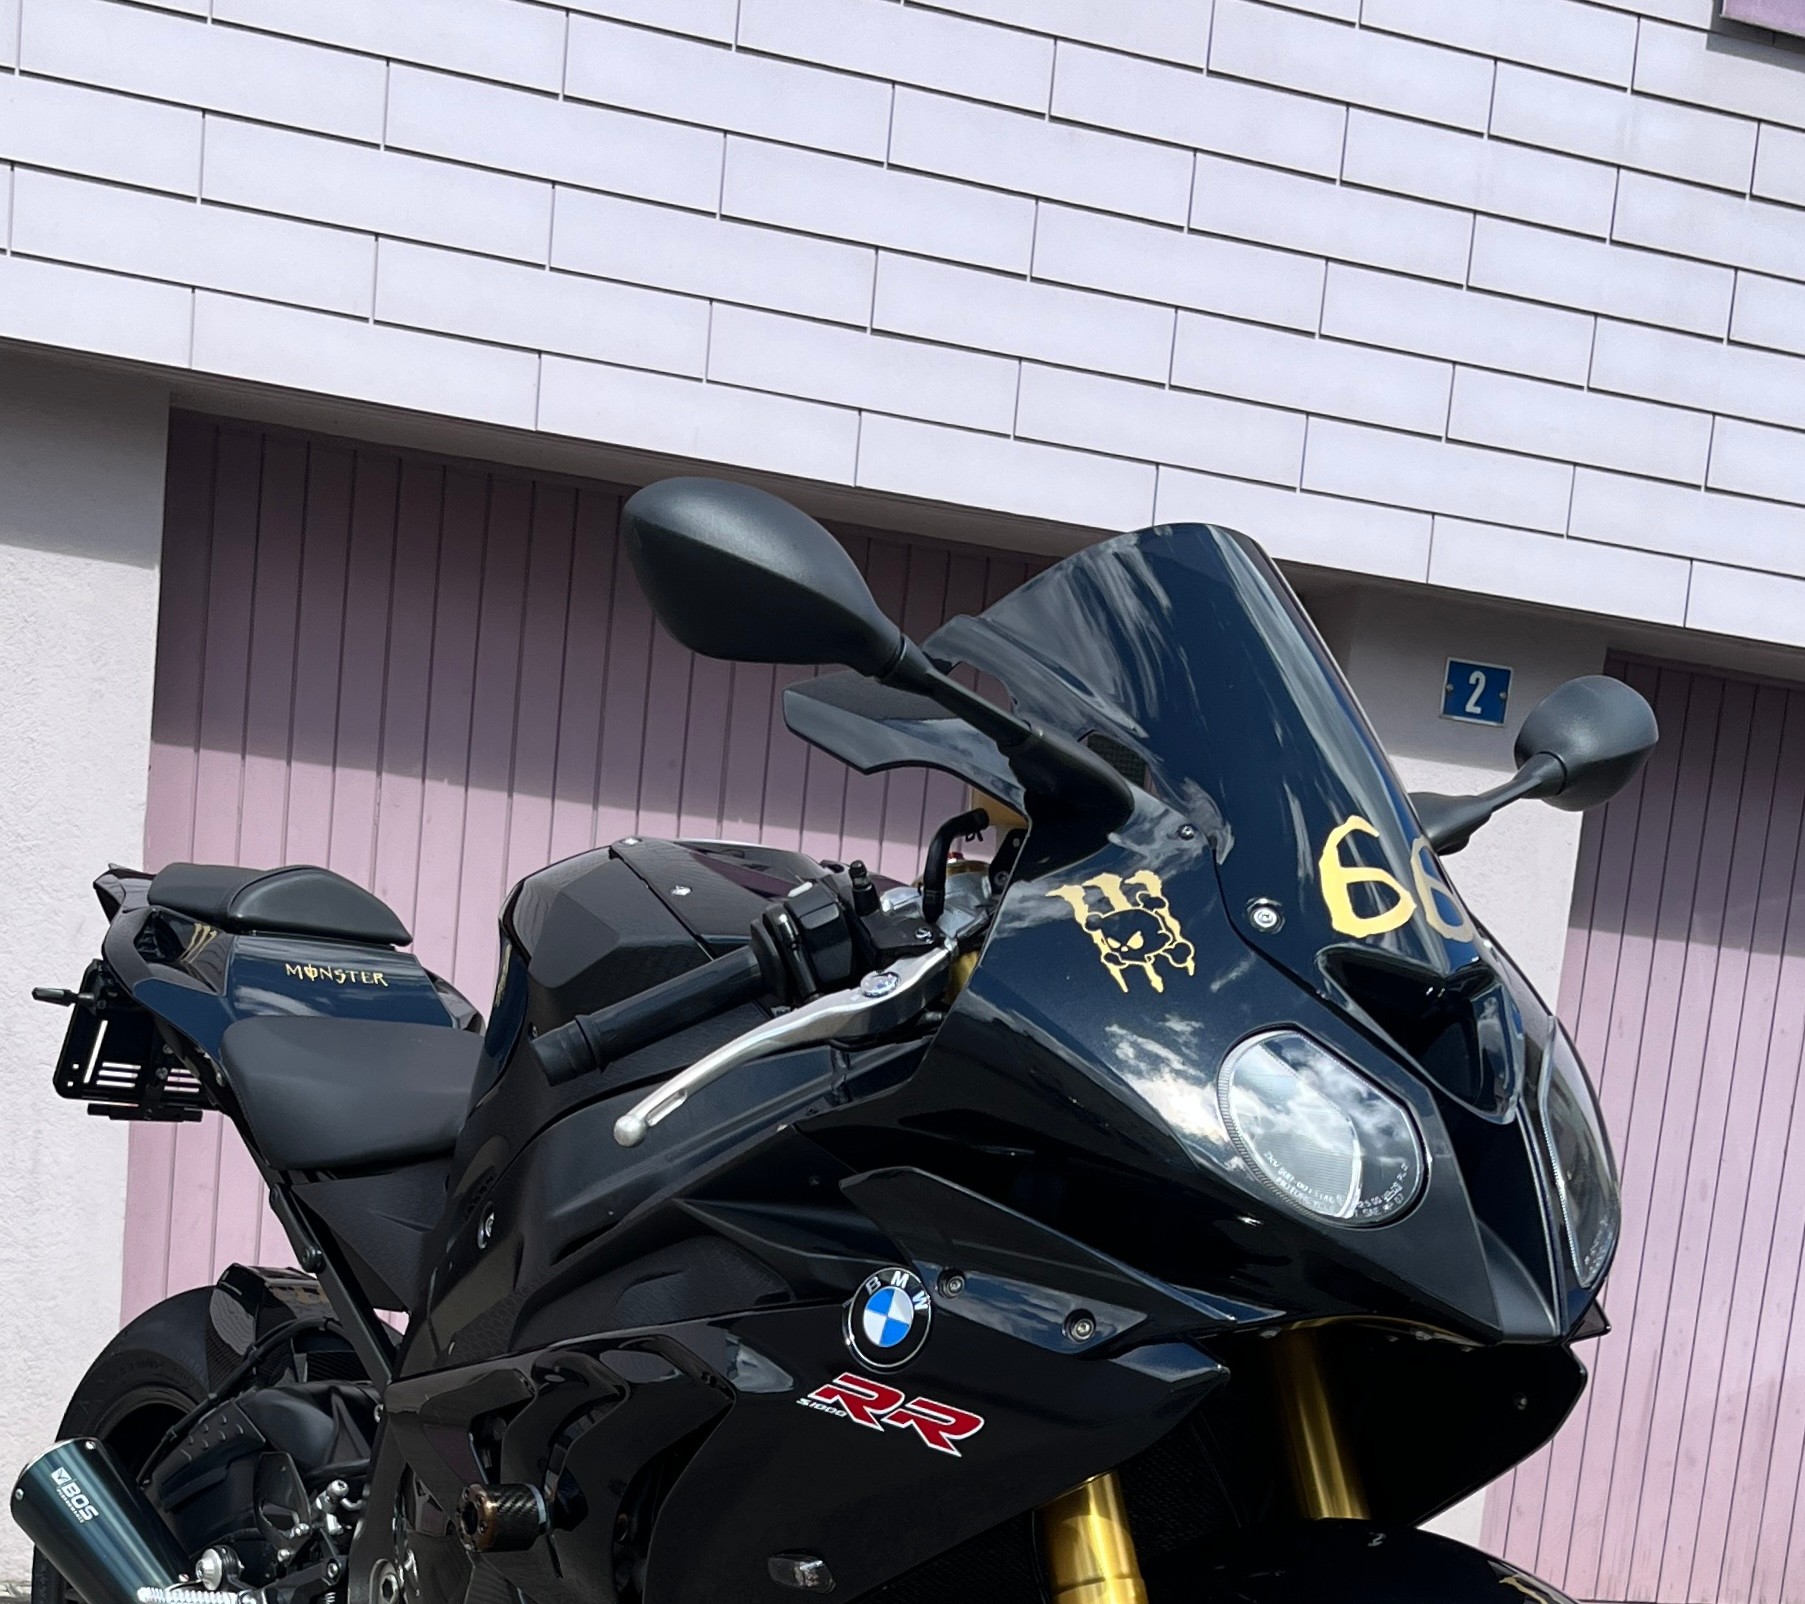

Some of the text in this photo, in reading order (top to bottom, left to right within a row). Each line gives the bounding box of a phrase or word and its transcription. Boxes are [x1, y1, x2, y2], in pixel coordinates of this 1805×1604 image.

[1465, 670, 1487, 714] 2
[1318, 815, 1475, 943] 66
[865, 1271, 930, 1311] BMW
[796, 1371, 985, 1458] S1000 RR
[61, 1481, 99, 1521] BOS
